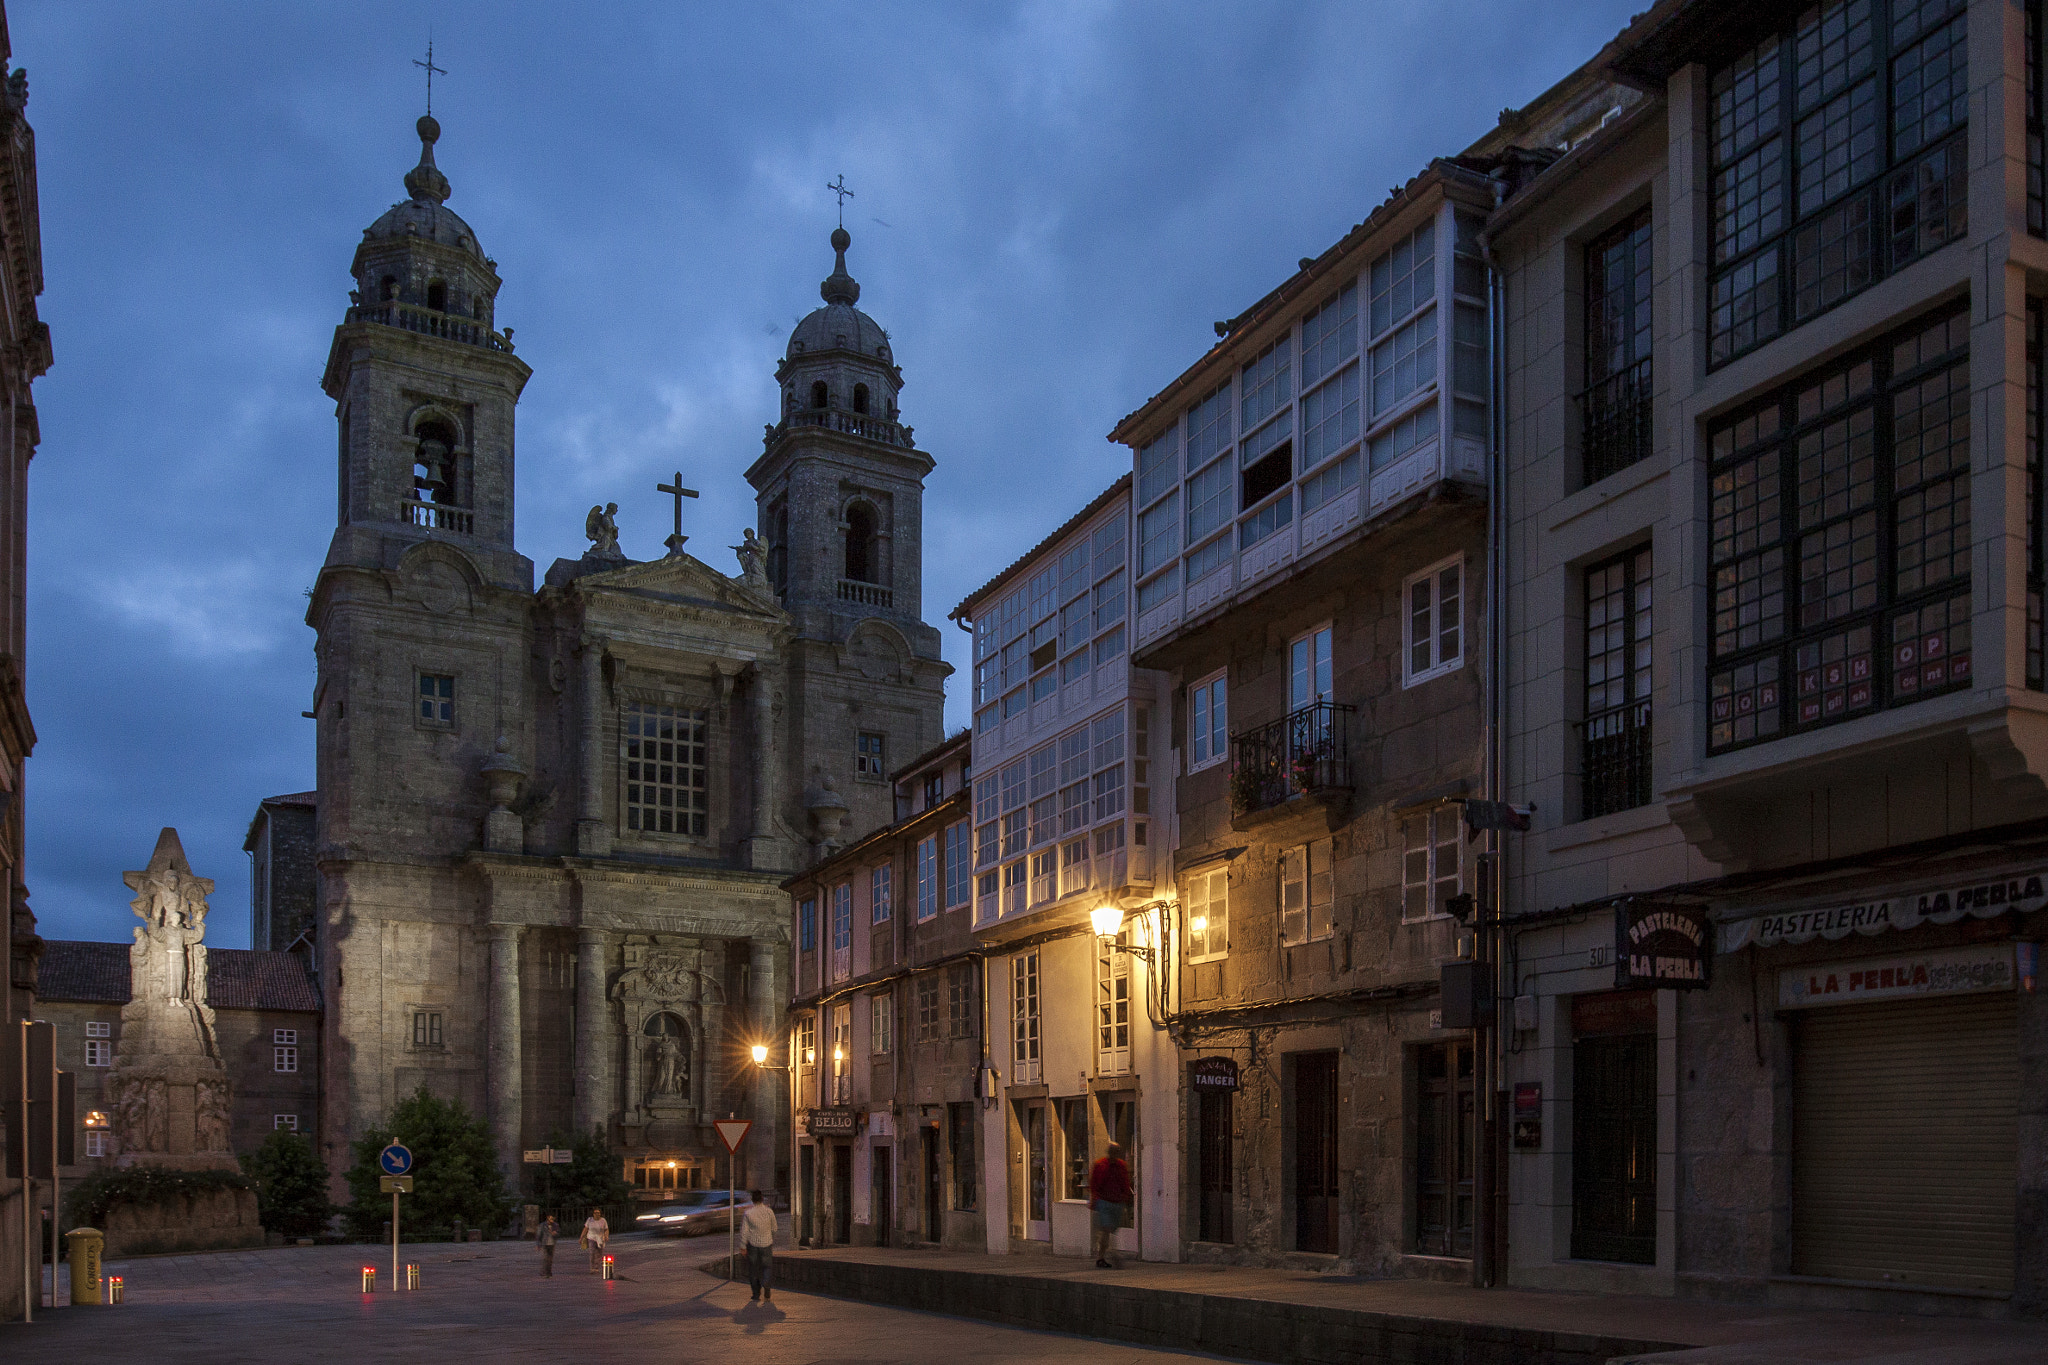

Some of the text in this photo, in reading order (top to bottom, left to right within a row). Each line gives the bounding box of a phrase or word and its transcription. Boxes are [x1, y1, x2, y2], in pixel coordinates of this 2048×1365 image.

[1760, 876, 2044, 937] PASTELERIA LA PERLA
[1629, 912, 1704, 948] PASTELERIA
[1589, 946, 1604, 966] 30
[1630, 954, 1705, 980] LA PERLA
[1810, 974, 1839, 995] LA
[1849, 964, 1928, 992] PERLA
[1195, 1074, 1235, 1086] TANGER
[814, 1117, 852, 1128] BELLO
[86, 1245, 96, 1291] CORREOS
